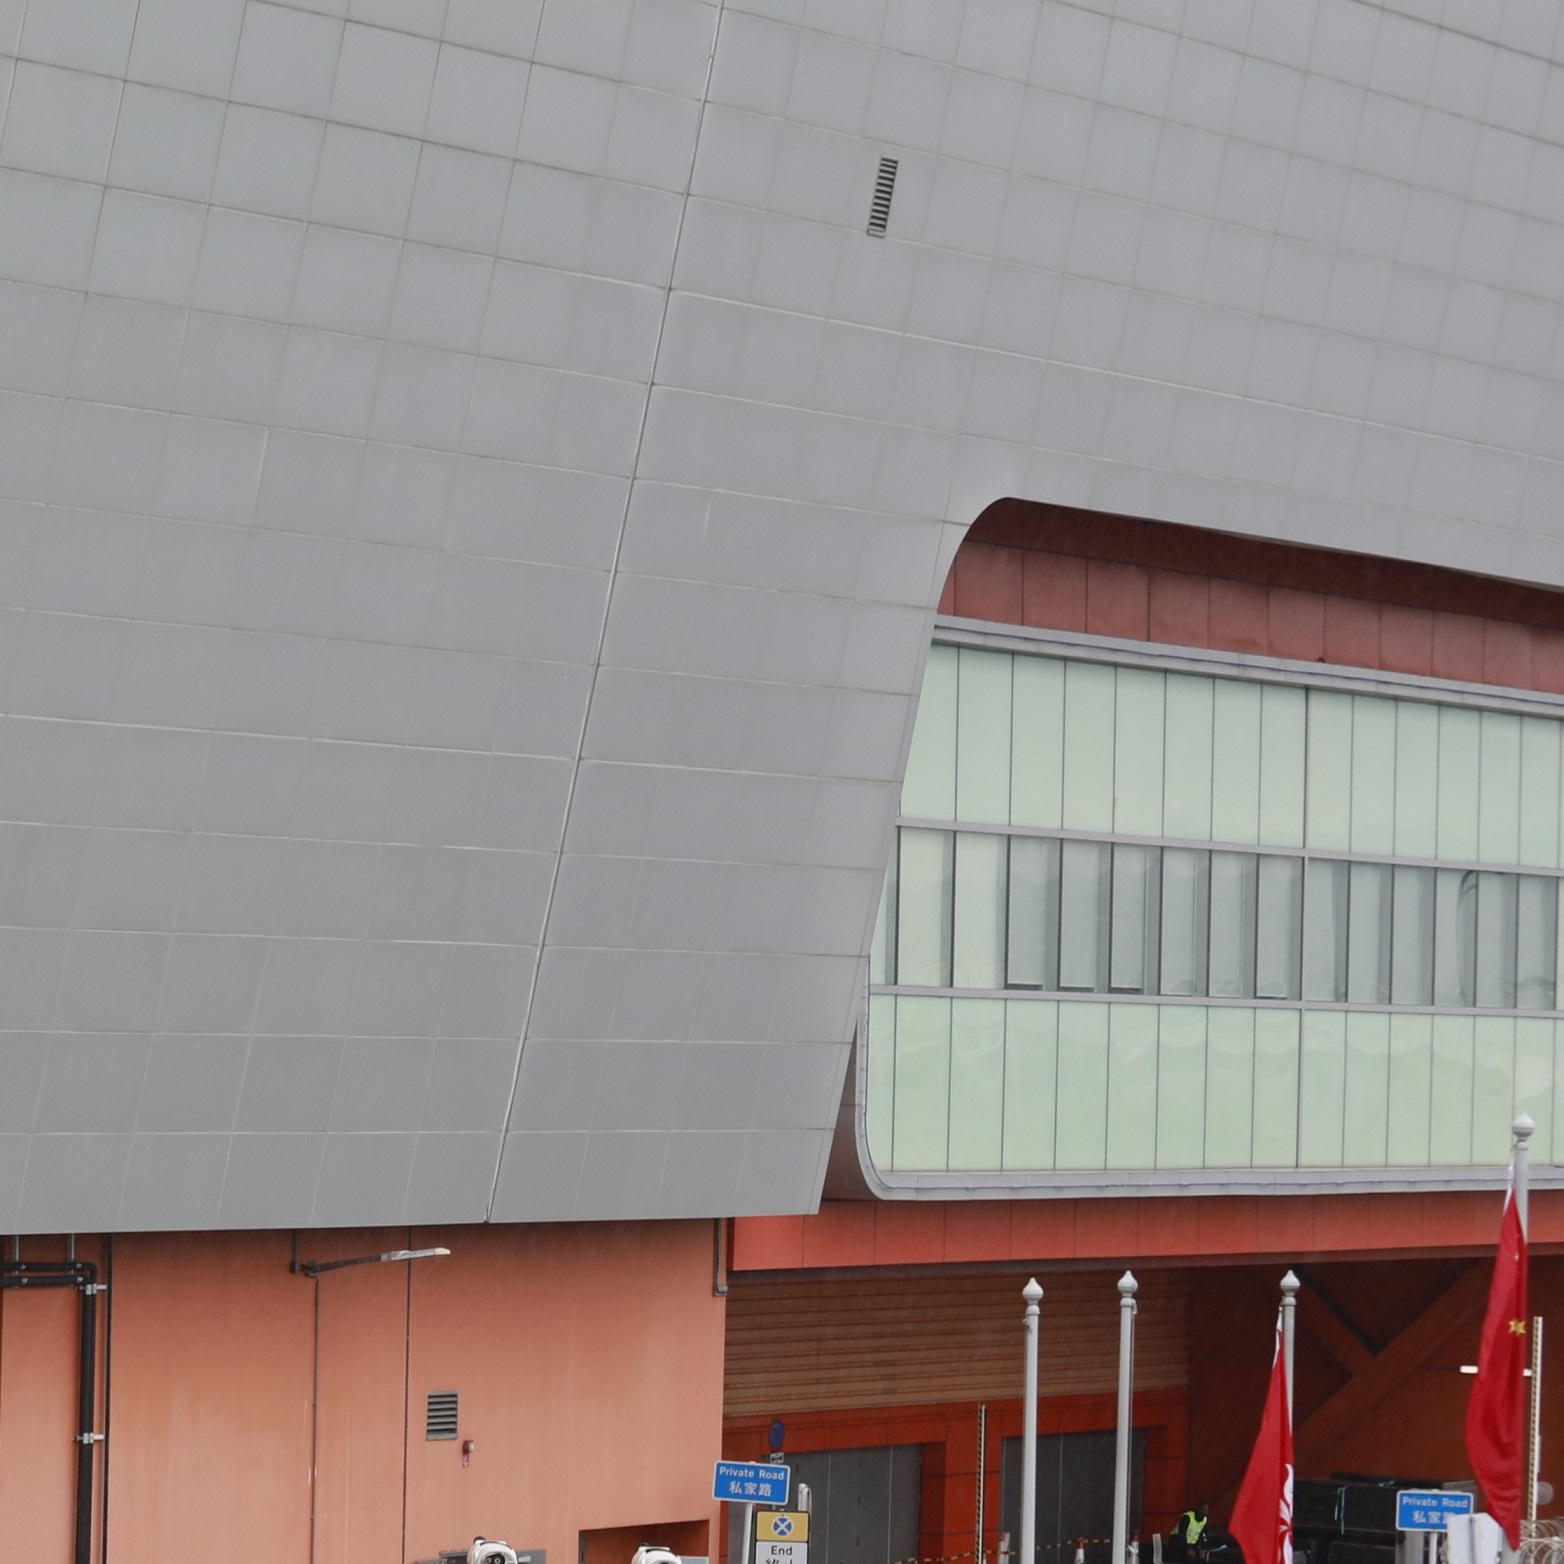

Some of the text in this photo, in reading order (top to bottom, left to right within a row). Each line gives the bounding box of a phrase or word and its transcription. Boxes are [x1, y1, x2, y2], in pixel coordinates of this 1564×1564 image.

[719, 1466, 784, 1481] Private Road
[728, 1480, 772, 1497] 私家路
[1401, 1495, 1469, 1509] Private Road
[771, 1545, 793, 1556] End
